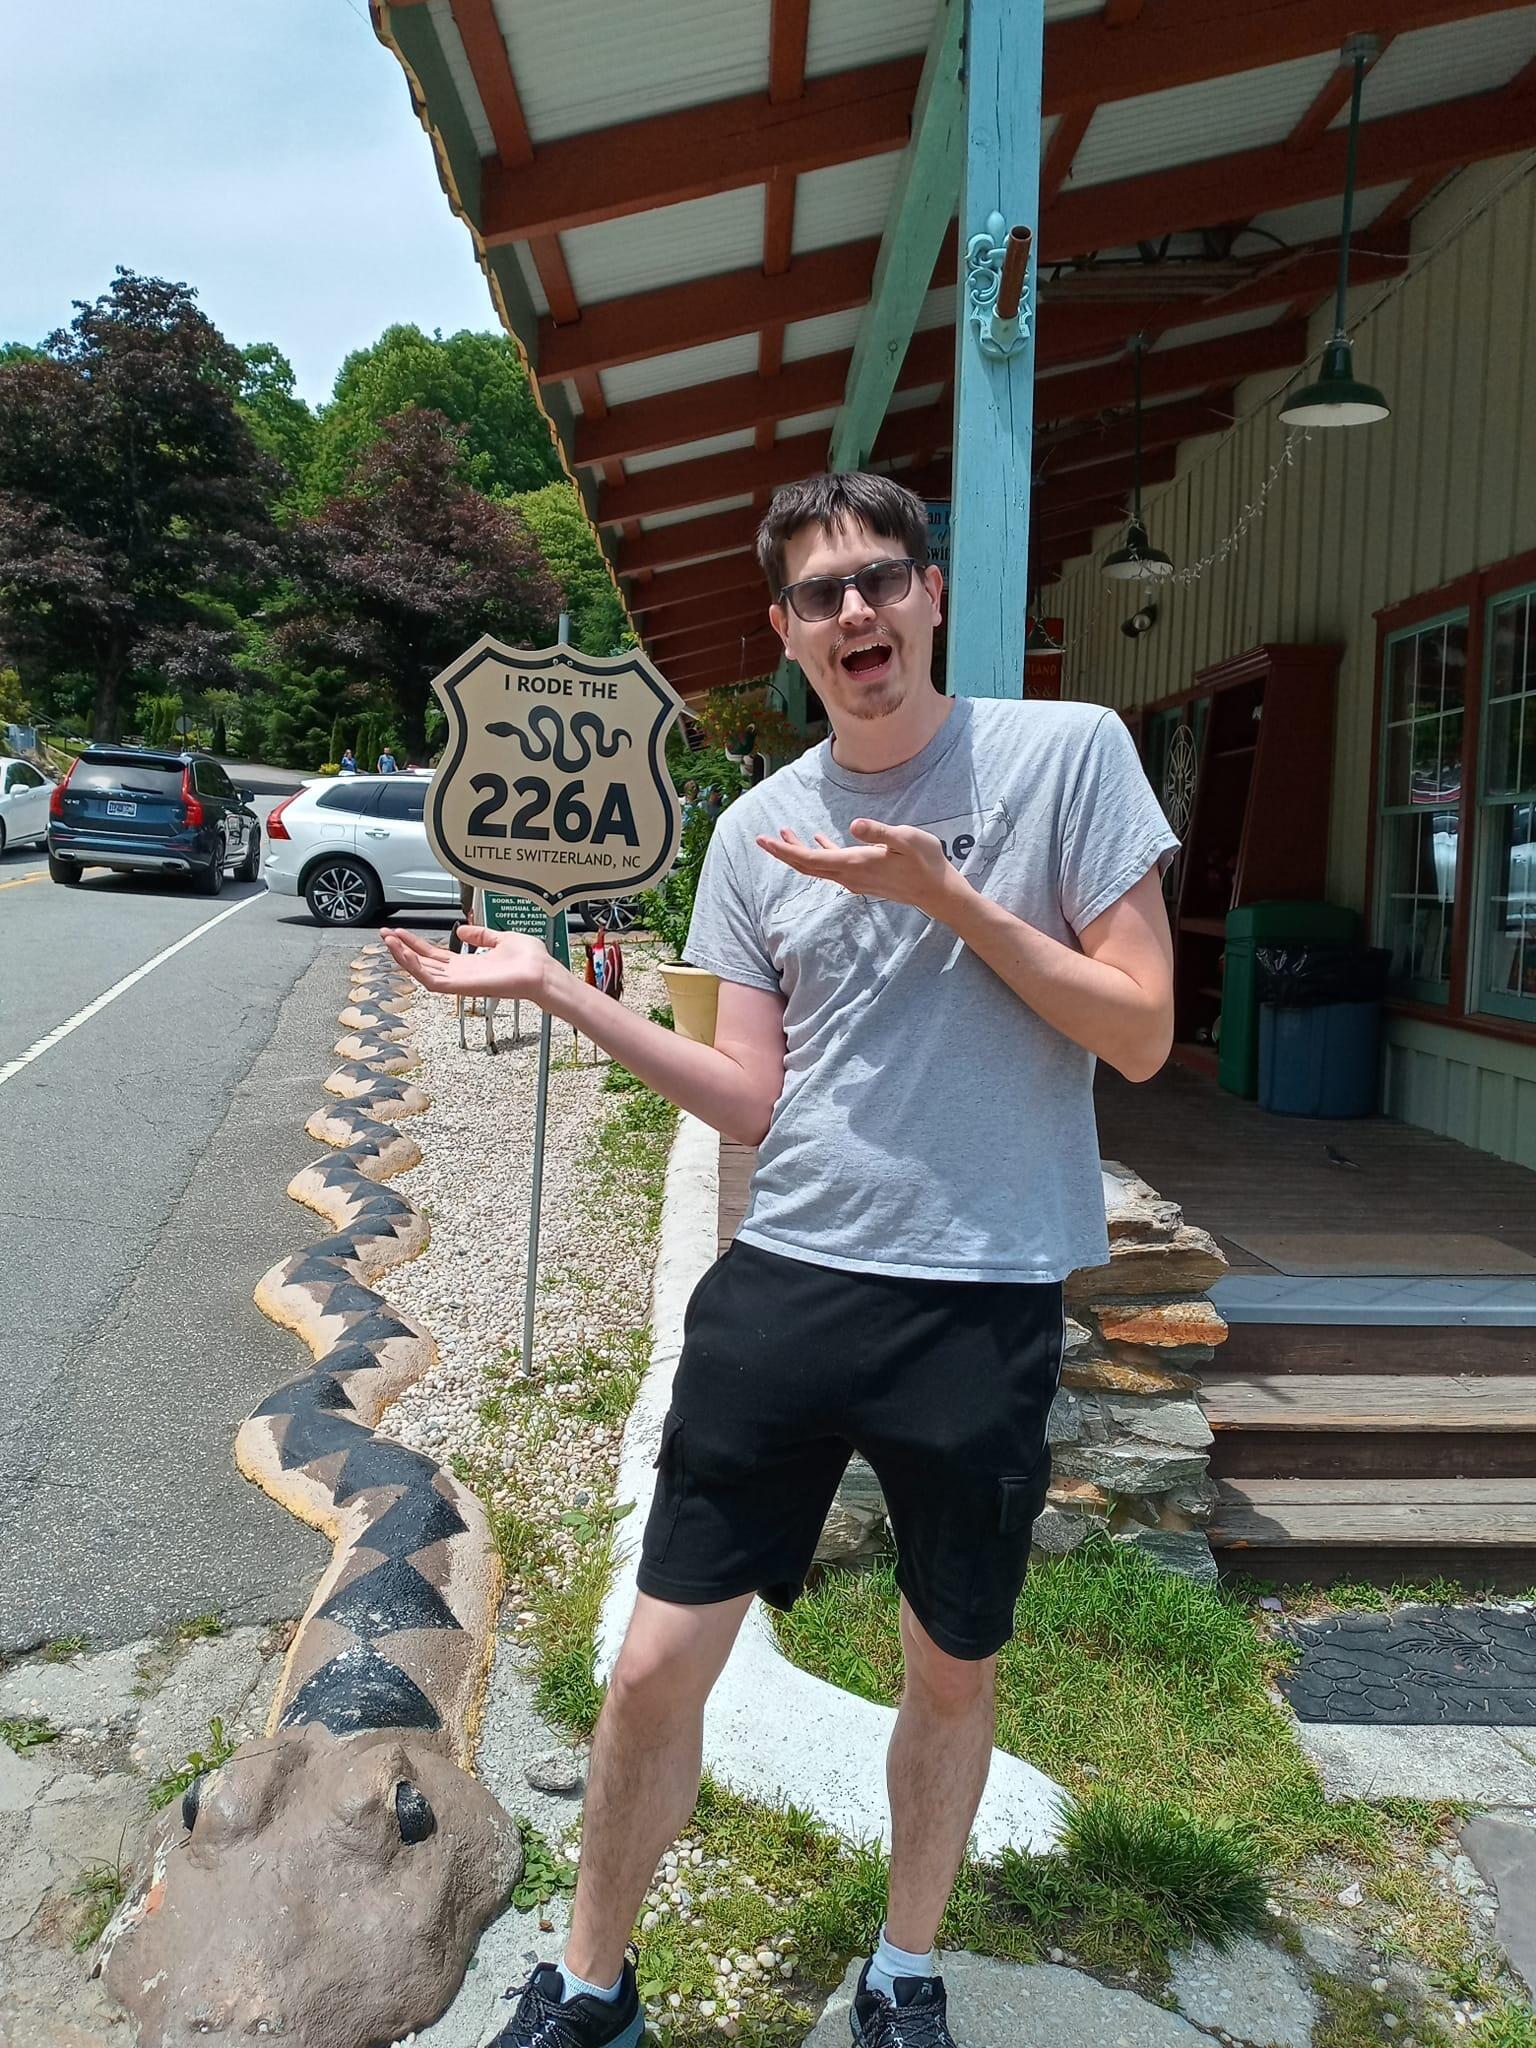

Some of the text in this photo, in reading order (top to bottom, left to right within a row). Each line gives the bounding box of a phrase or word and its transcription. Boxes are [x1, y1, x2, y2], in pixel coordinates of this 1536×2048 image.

[505, 674, 618, 699] I RODE THE
[467, 773, 640, 847] 226A
[464, 845, 641, 869] LITTLE SWITZERLAND, NC
